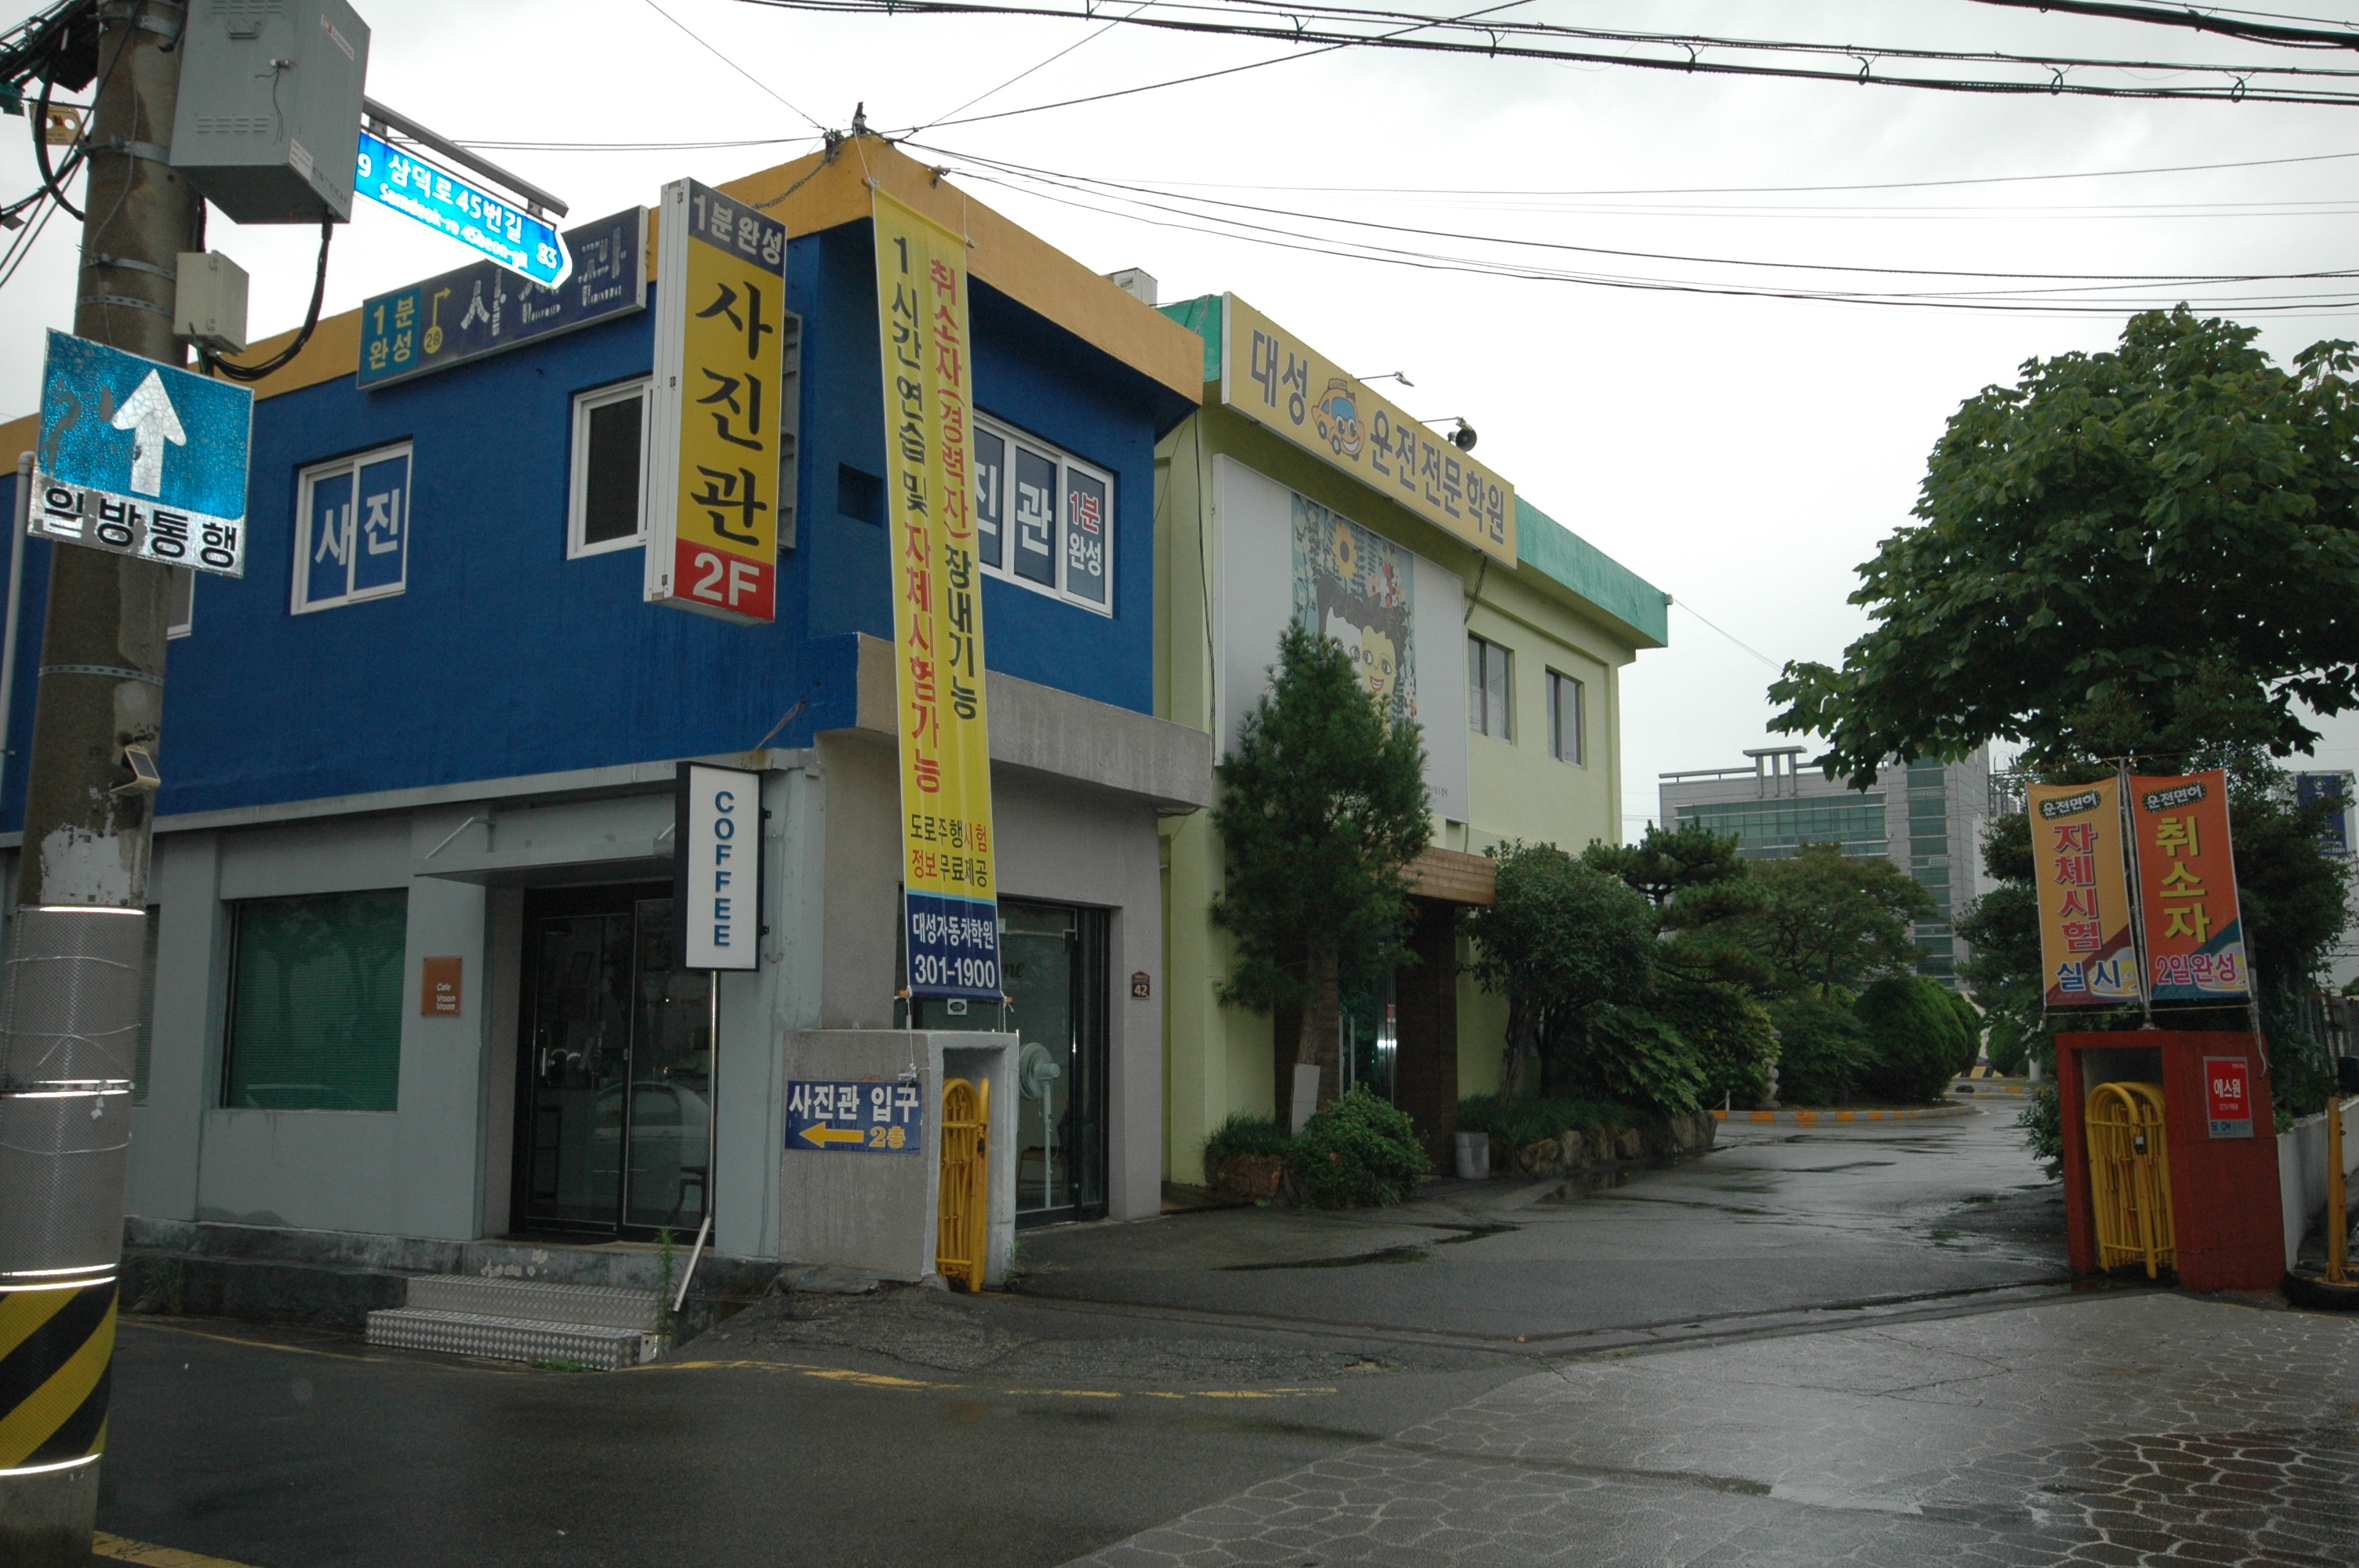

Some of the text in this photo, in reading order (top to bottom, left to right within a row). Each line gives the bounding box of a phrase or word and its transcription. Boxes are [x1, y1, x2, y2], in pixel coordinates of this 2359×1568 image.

[380, 183, 460, 236] Samdeok-ro
[536, 243, 558, 268] 83
[373, 296, 414, 335] 1분
[425, 328, 442, 347] 2층
[369, 330, 413, 369] 완성
[1250, 328, 1308, 426] 대성
[691, 281, 773, 546] 사진관
[896, 375, 924, 466] 연습
[903, 470, 928, 517] 및
[1369, 408, 1503, 546] 운전전문학원
[314, 488, 399, 567] 사진
[1070, 491, 1101, 535] 1분
[1069, 532, 1102, 576] 완성
[691, 552, 760, 607] 2F
[945, 543, 977, 720] 장내기능
[2043, 792, 2097, 816] 운전면허
[2146, 786, 2203, 811] 운전면허
[714, 791, 735, 947] COFFEE
[2052, 822, 2102, 953] 자체시험
[2156, 815, 2212, 943] 취소자
[913, 913, 994, 949] 대성자동차학원
[914, 954, 995, 988] 301-1900
[1134, 984, 1147, 996] 42
[2057, 960, 2122, 993] 실시
[788, 1083, 919, 1123] 사진관 입구
[2214, 1078, 2241, 1098] 에스원
[869, 1125, 907, 1149] 2층
